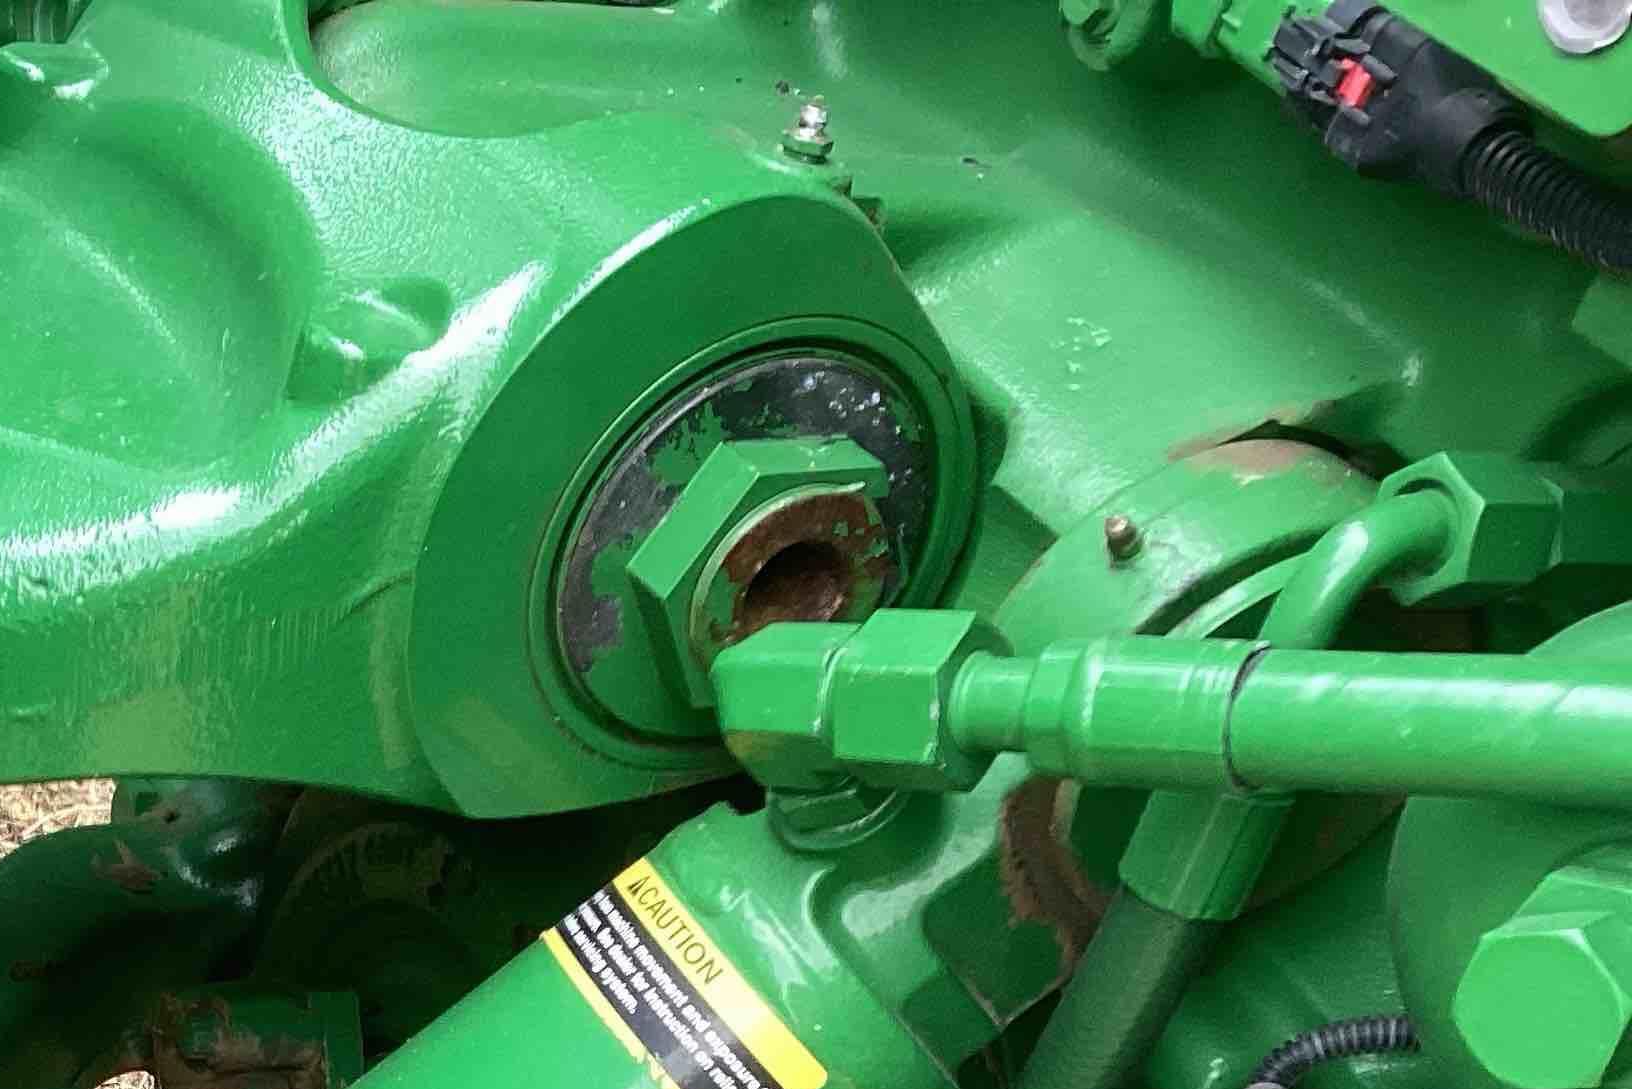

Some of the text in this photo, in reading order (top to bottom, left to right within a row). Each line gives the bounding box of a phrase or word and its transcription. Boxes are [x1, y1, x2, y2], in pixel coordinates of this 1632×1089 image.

[634, 883, 726, 986] CAUTION
[596, 964, 643, 1016] system.
[628, 969, 653, 994] for
[631, 942, 691, 1009] movement
[680, 1001, 711, 1034] and
[640, 985, 704, 1056] instruction
[692, 1047, 716, 1071] on
